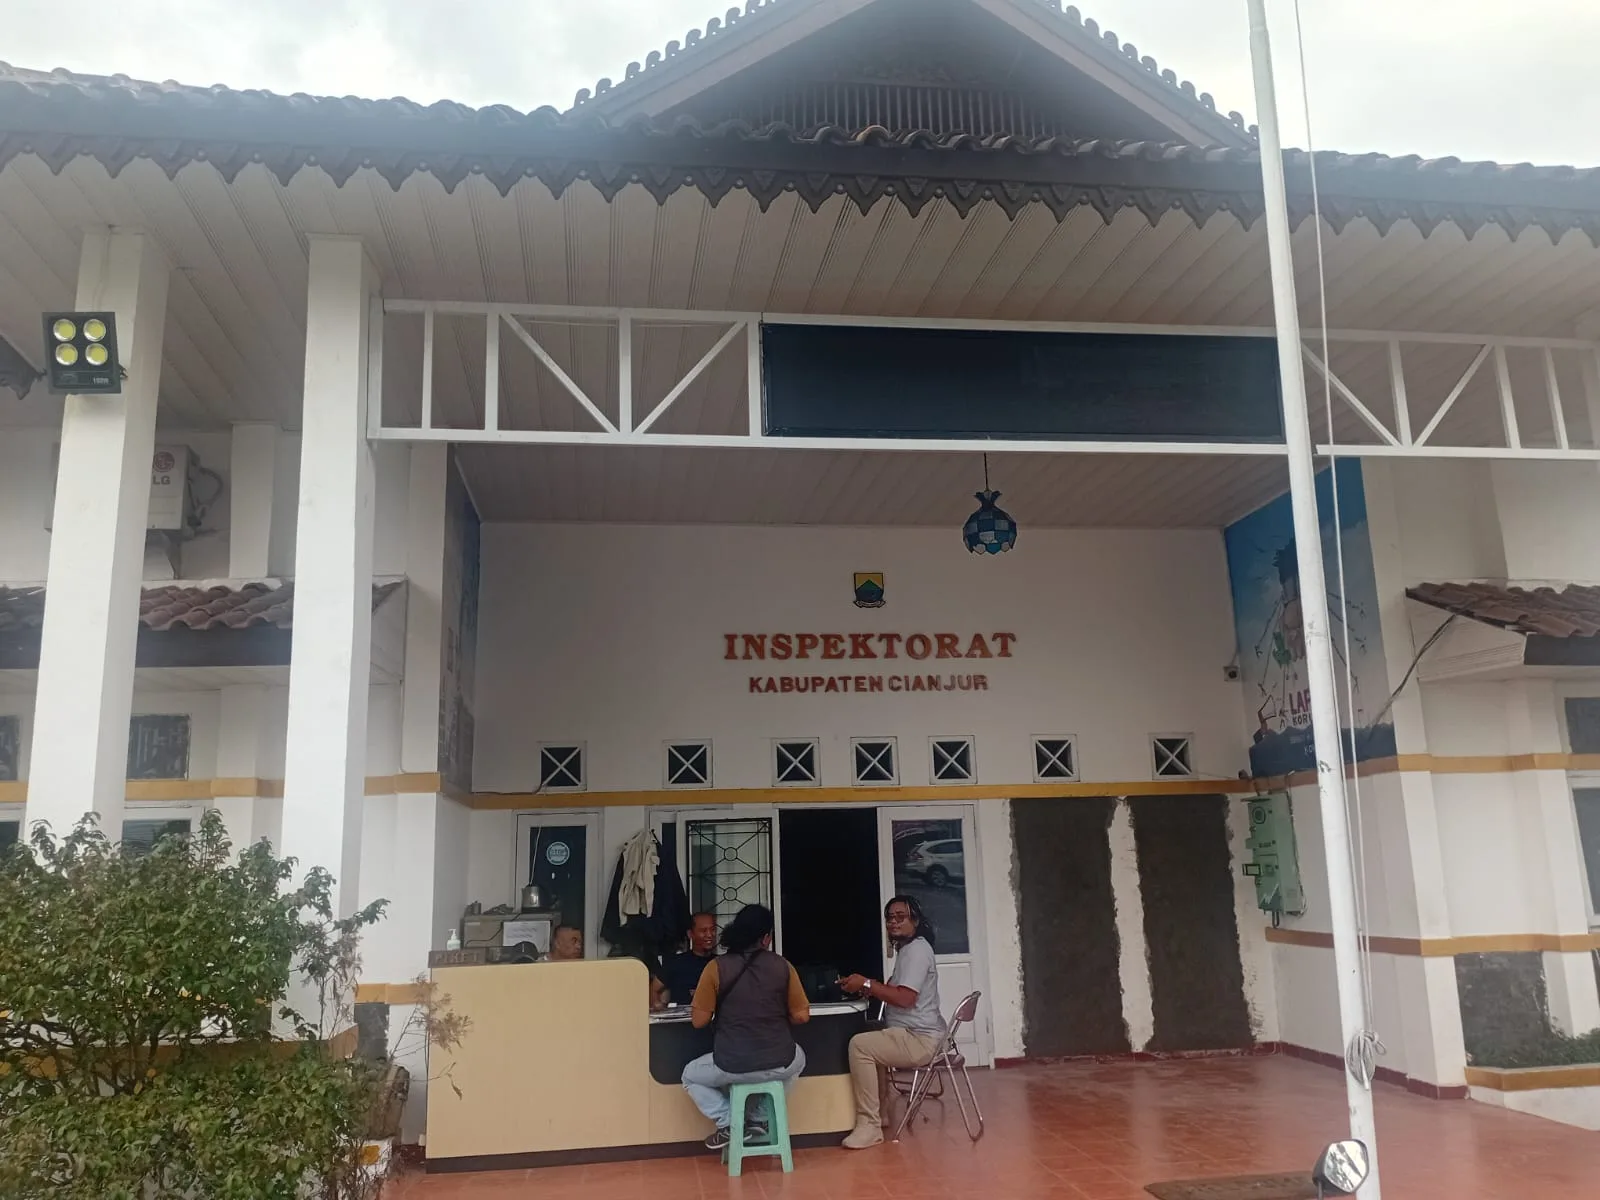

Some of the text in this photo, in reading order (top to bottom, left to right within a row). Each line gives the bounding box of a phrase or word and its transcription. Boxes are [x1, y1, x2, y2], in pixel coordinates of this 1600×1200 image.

[153, 475, 171, 485] LG
[724, 632, 1017, 660] INSPEKTORAT
[749, 674, 989, 693] KABUPATEN CIANJUR
[435, 951, 480, 964] PIKET
